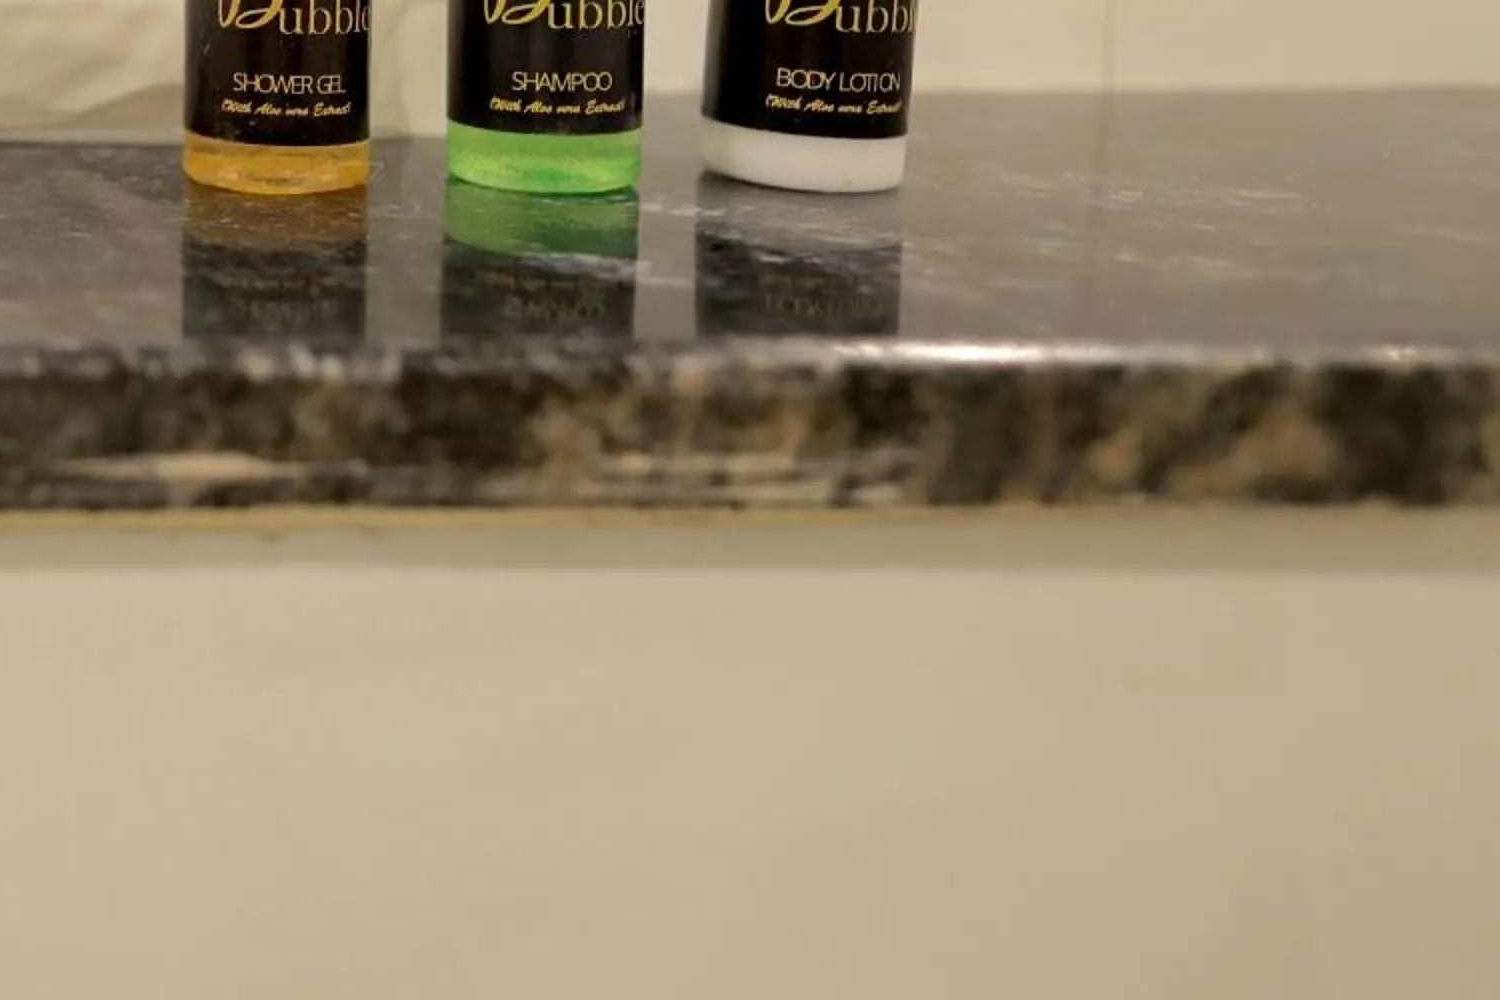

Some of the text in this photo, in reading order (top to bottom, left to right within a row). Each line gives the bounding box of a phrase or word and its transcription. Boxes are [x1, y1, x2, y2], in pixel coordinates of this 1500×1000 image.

[232, 72, 347, 94] SHOWER GEL
[511, 71, 613, 92] SHAMPOO
[775, 67, 901, 93] BODY LOTION
